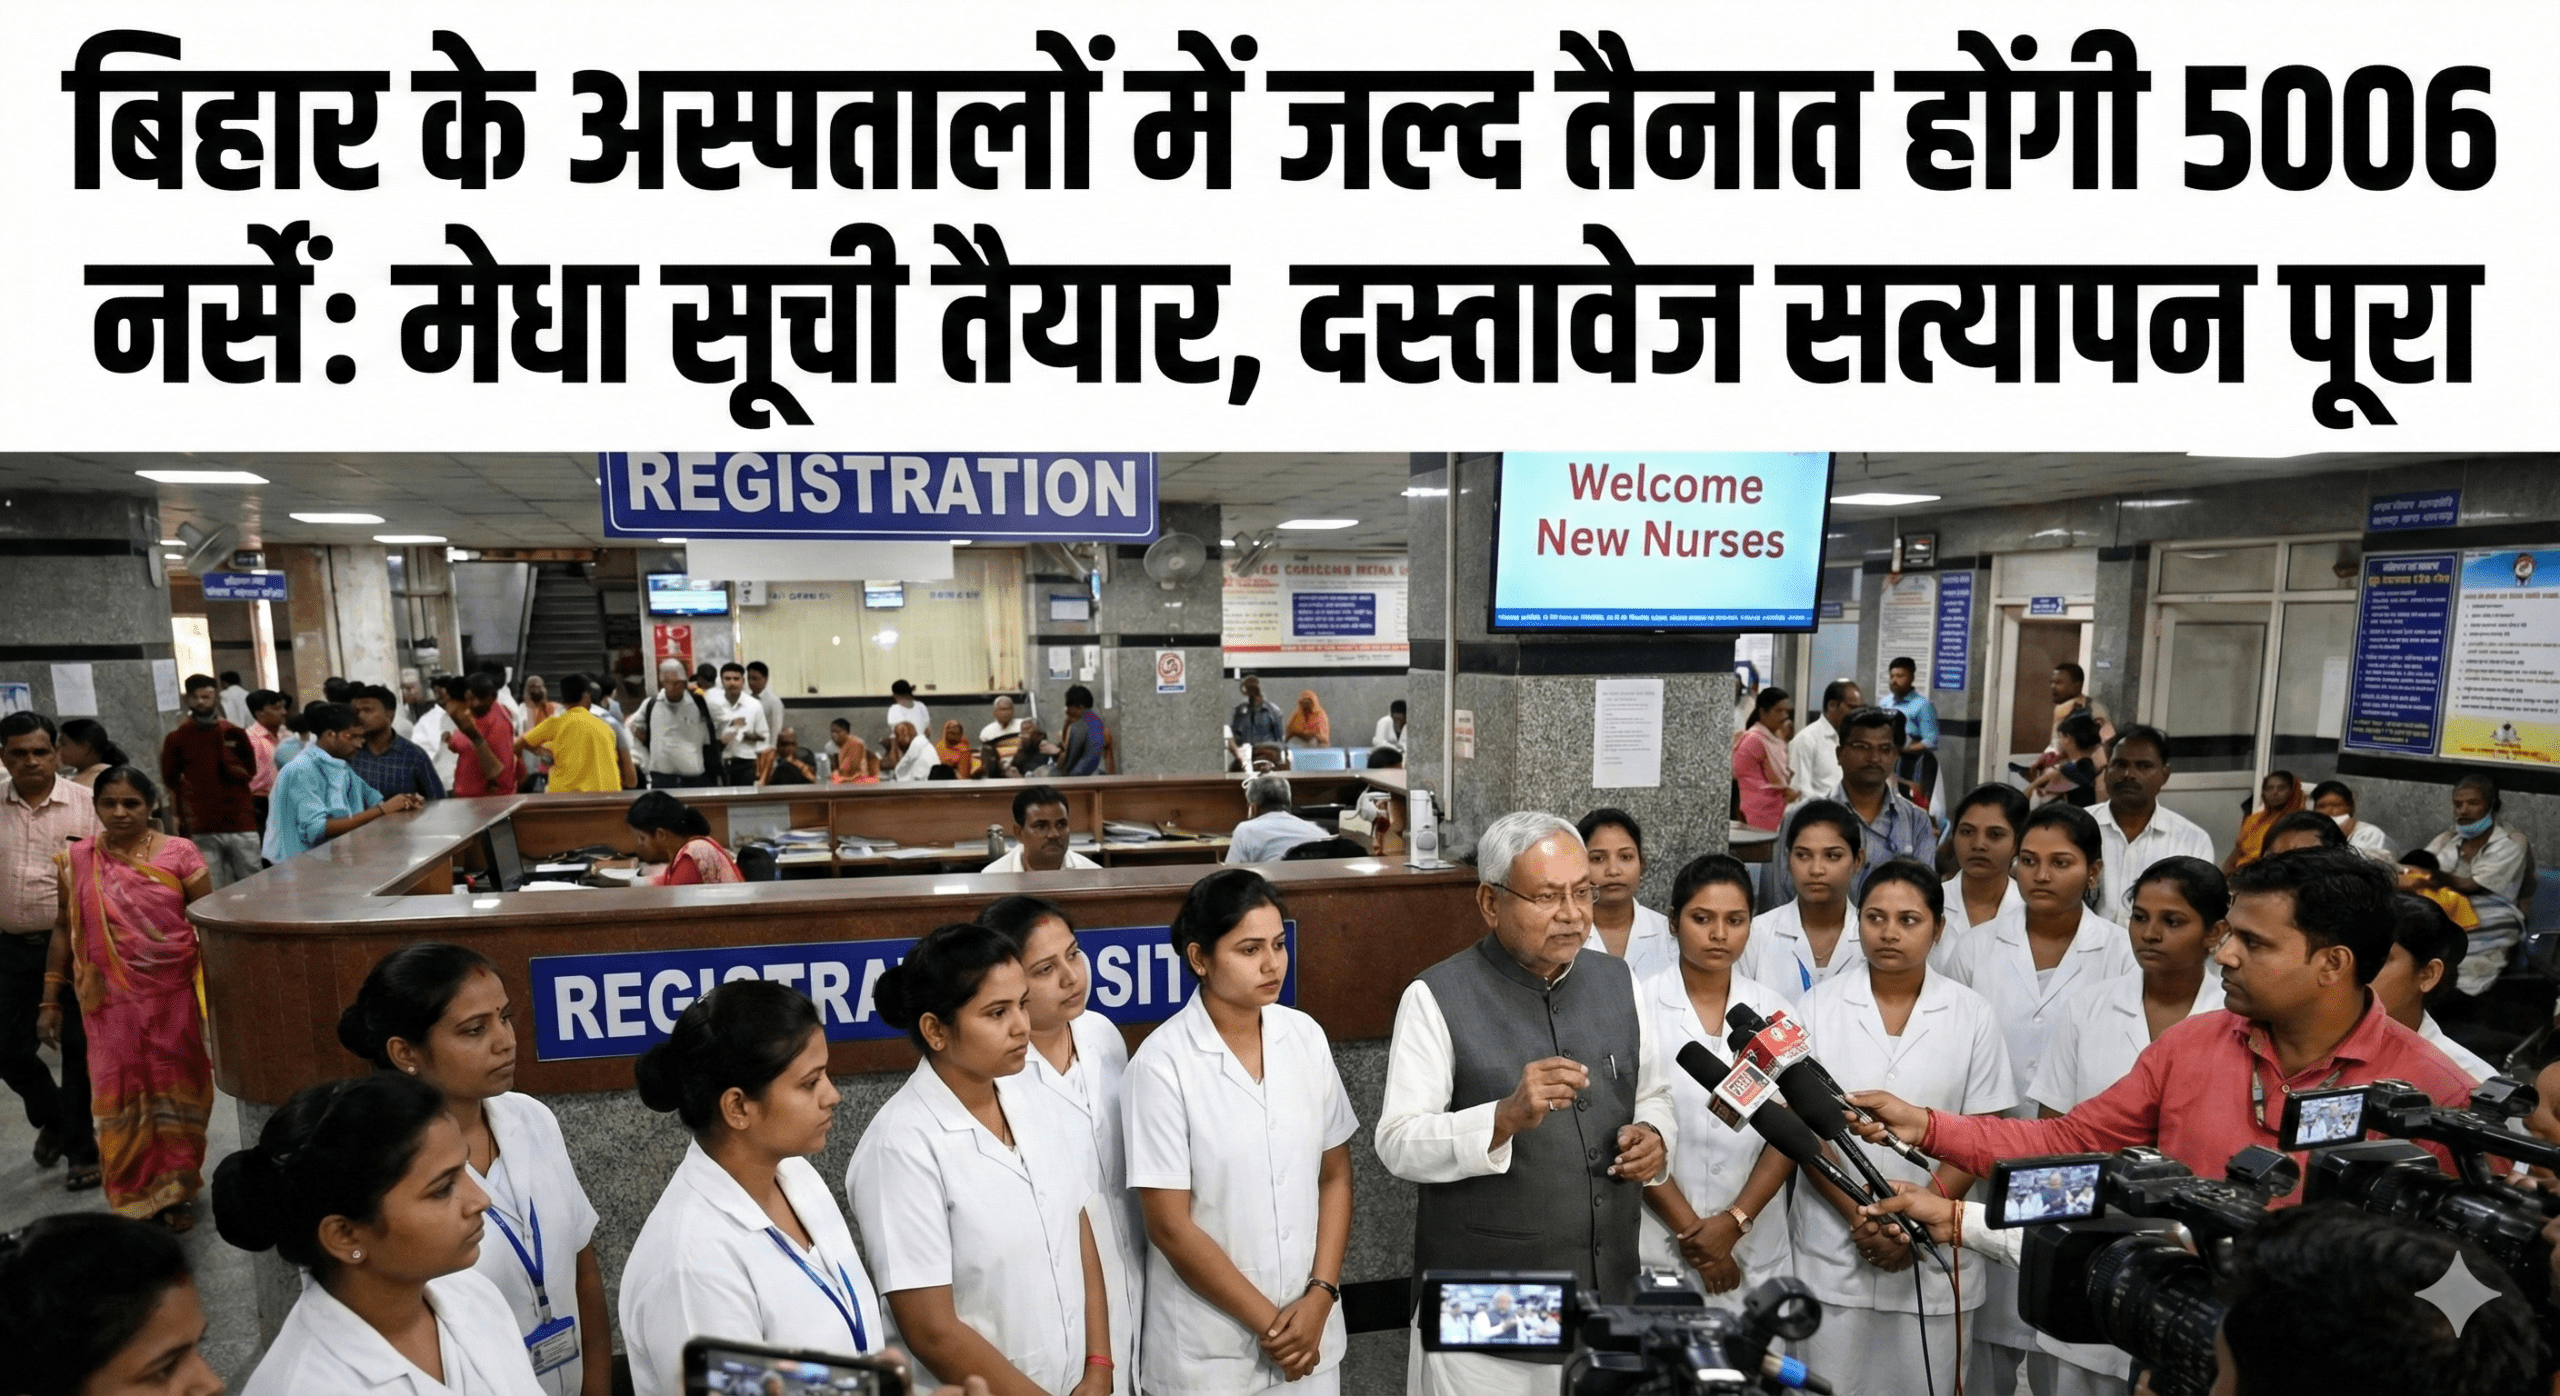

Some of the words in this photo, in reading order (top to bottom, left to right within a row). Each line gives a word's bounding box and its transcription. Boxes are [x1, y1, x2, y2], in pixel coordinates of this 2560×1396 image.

[627, 452, 1136, 517] REGISTRATION
[1568, 462, 1764, 505] Welcome
[1537, 518, 1630, 557] New
[1644, 520, 1785, 559] Nurses
